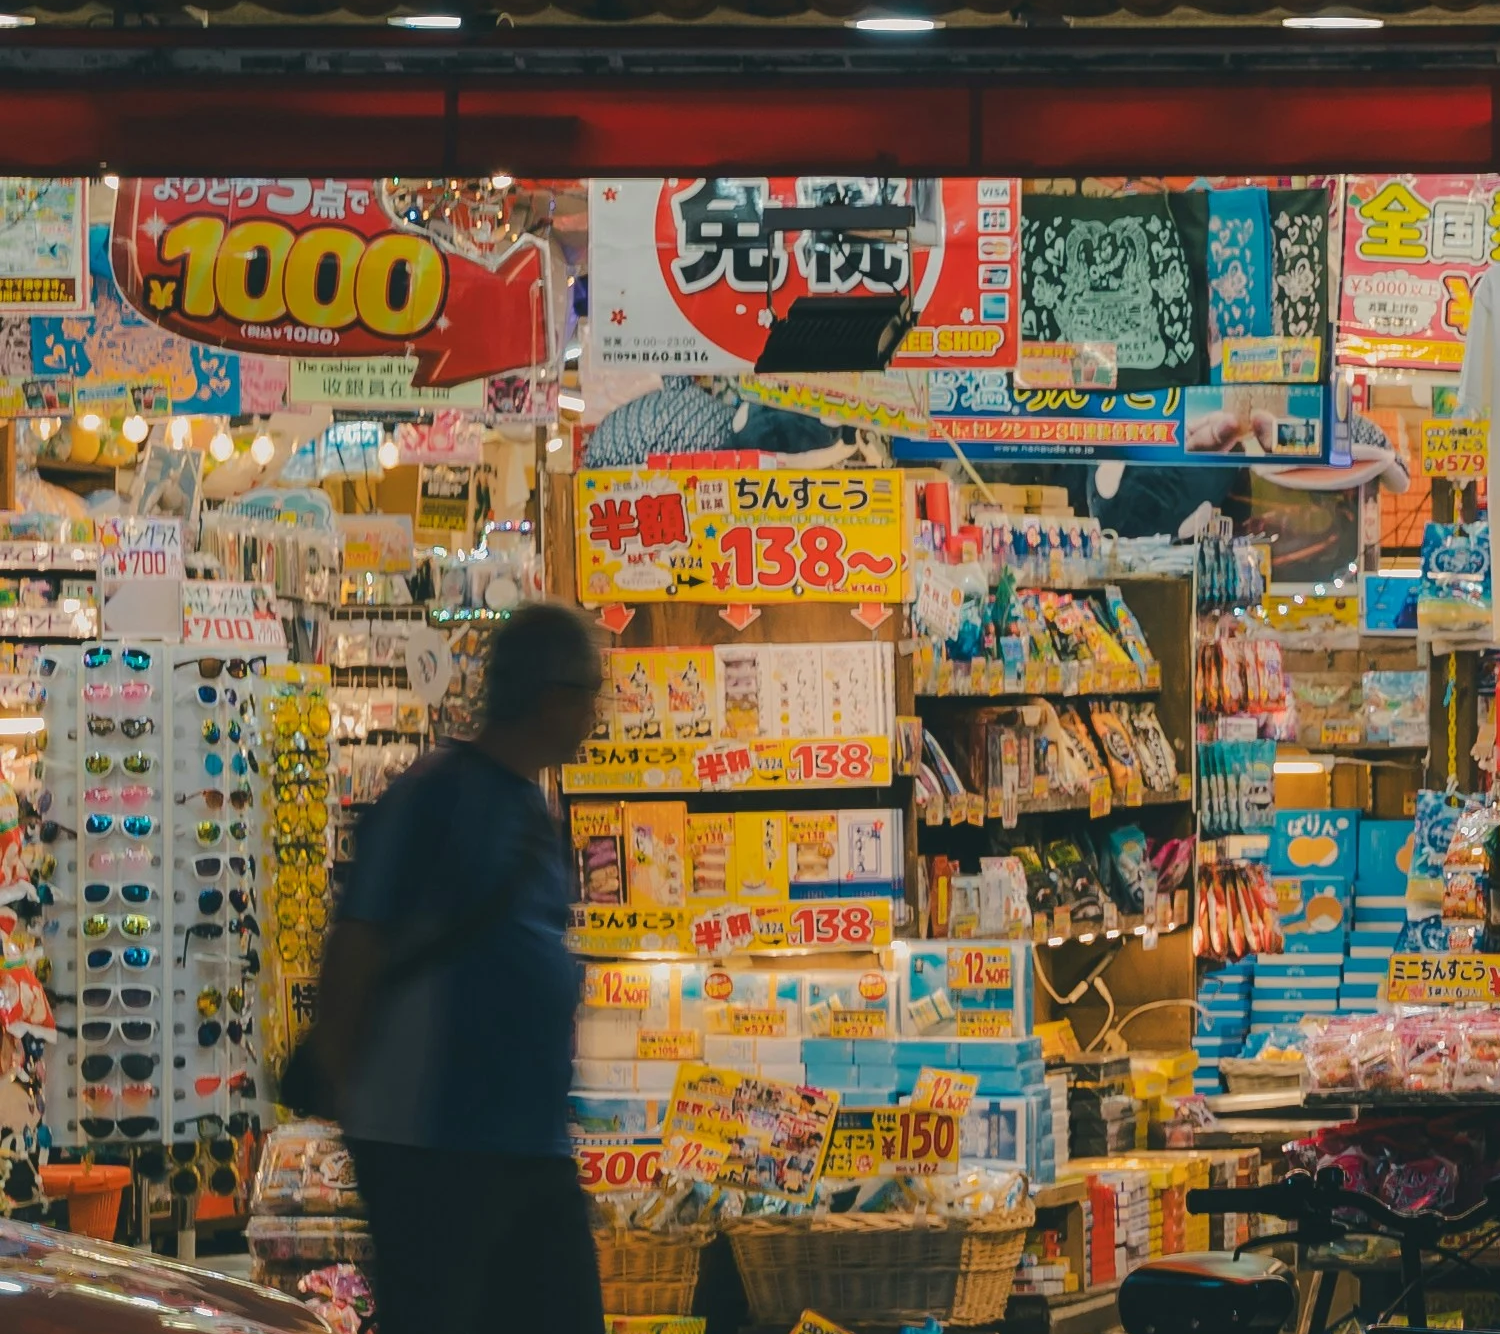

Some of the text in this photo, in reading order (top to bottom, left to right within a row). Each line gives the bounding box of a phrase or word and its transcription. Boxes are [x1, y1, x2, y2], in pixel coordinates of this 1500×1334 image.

[981, 187, 1008, 198] VISA
[939, 329, 1002, 354] SHOP
[297, 361, 318, 373] The
[324, 363, 362, 374] cashier
[366, 363, 377, 374] is
[734, 477, 869, 510] ちんすこう
[590, 493, 688, 551] 半額
[589, 747, 677, 765] ちんすこう
[696, 749, 752, 785] 半額
[589, 912, 676, 930] ちんすこう
[694, 912, 753, 952] 半額
[1393, 958, 1486, 981] ミニちんすこう
